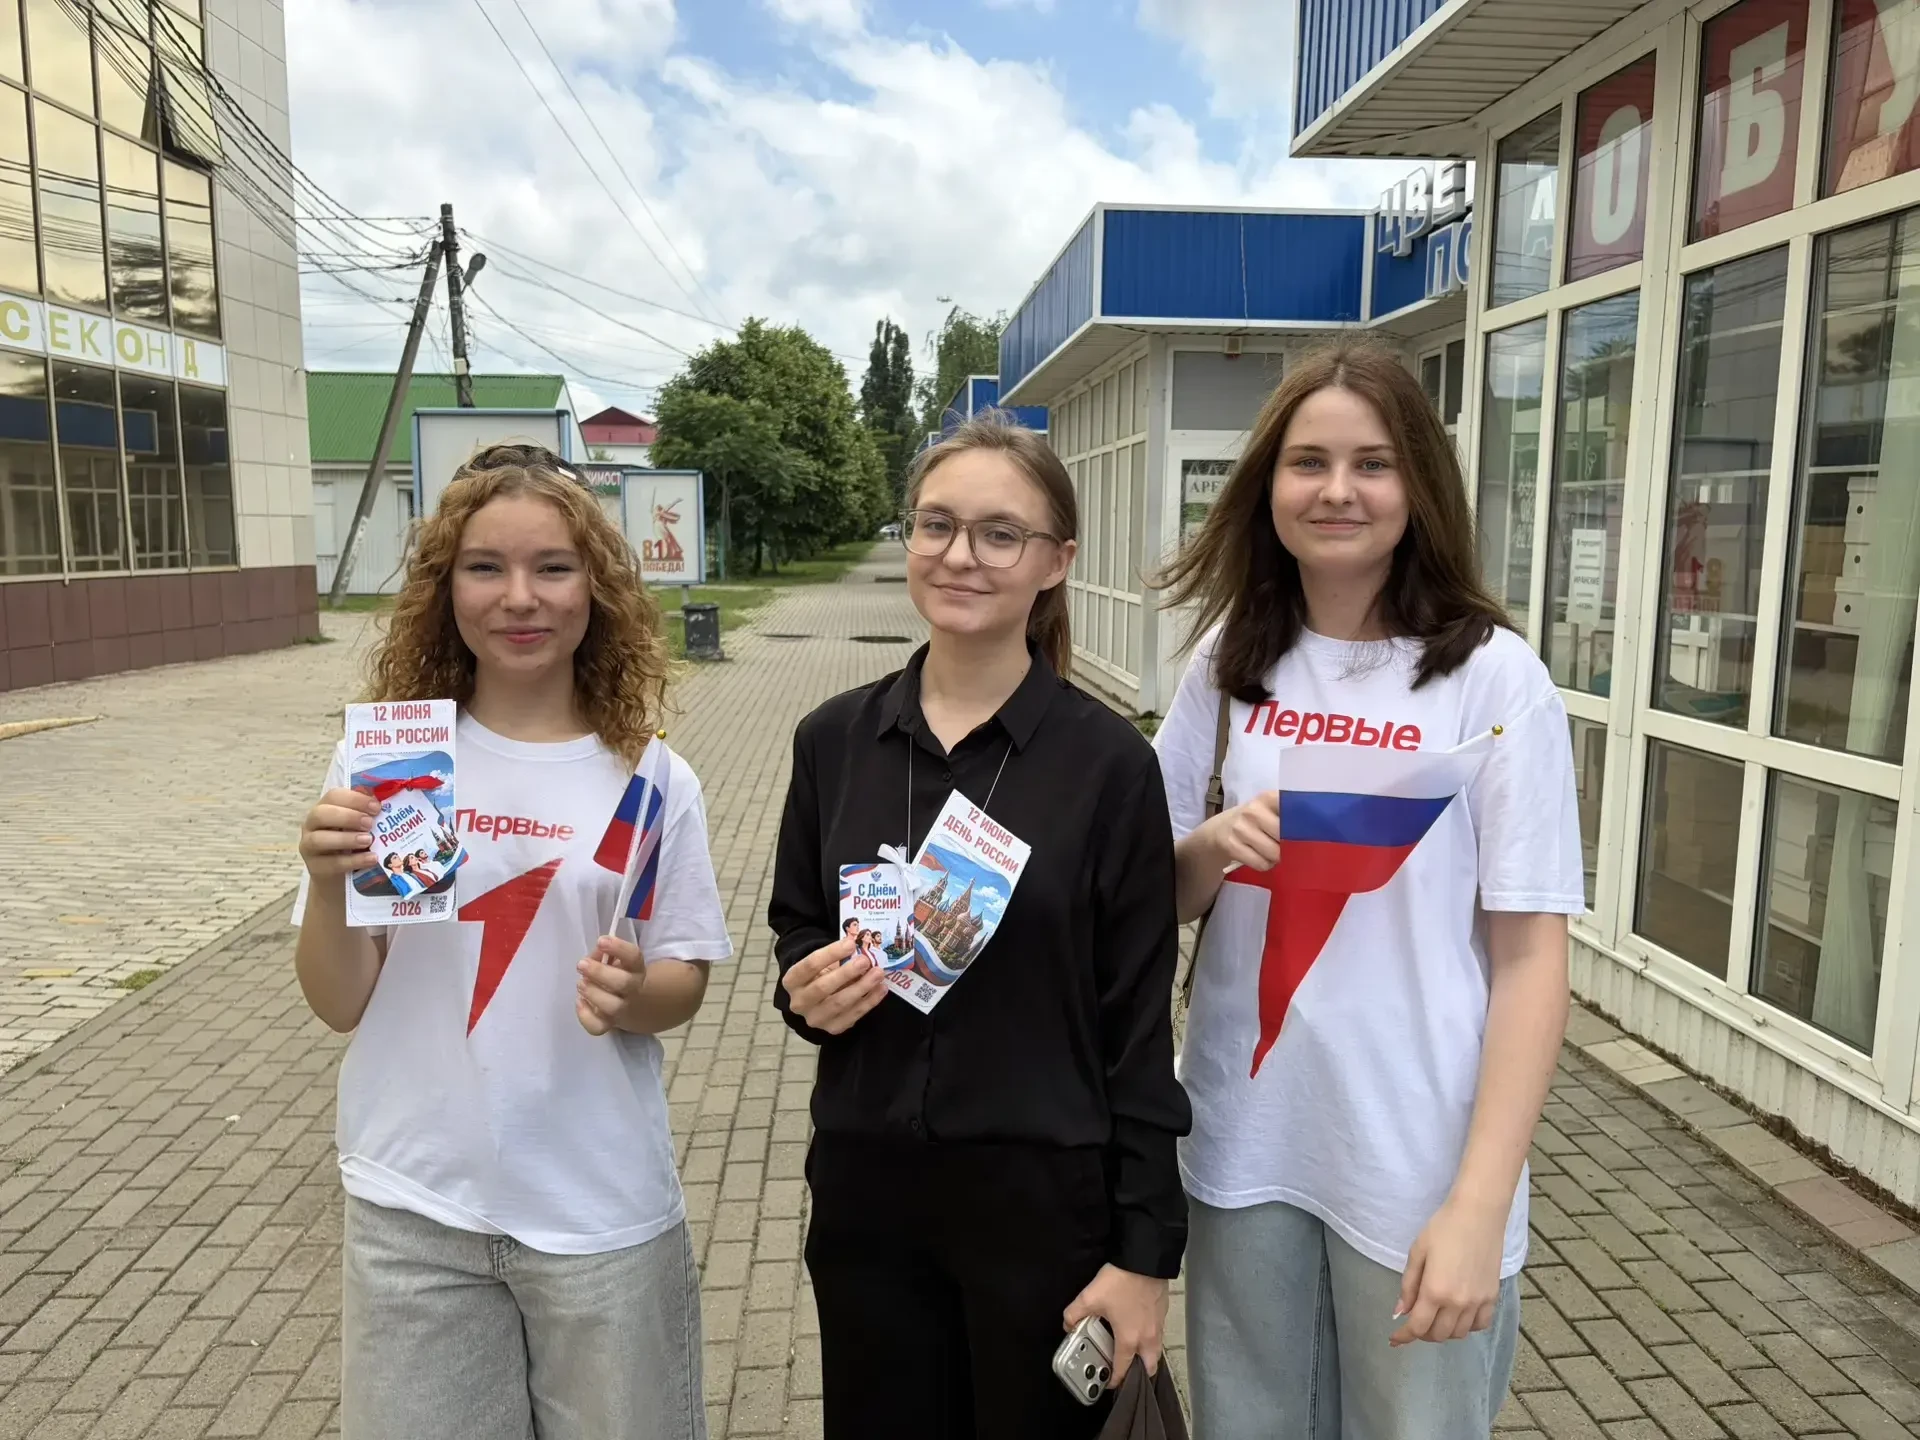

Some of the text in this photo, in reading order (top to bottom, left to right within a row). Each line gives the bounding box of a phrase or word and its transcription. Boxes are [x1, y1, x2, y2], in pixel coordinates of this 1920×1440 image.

[0, 300, 198, 378] СЕКОНД
[373, 703, 431, 721] 12 ИЮНЯ
[1244, 700, 1421, 752] Первые
[354, 726, 449, 748] ДЕНЬ РОССИИ
[376, 804, 415, 834] С Днём
[379, 809, 427, 848] России!
[455, 808, 575, 842] Первые
[967, 806, 1014, 848] 12 ИЮНЯ
[943, 814, 1020, 874] ДЕНЬ РОССИИ
[853, 895, 901, 910] России!
[858, 883, 897, 898] С Днём
[391, 901, 421, 917] 2026
[885, 969, 915, 991] 2026
